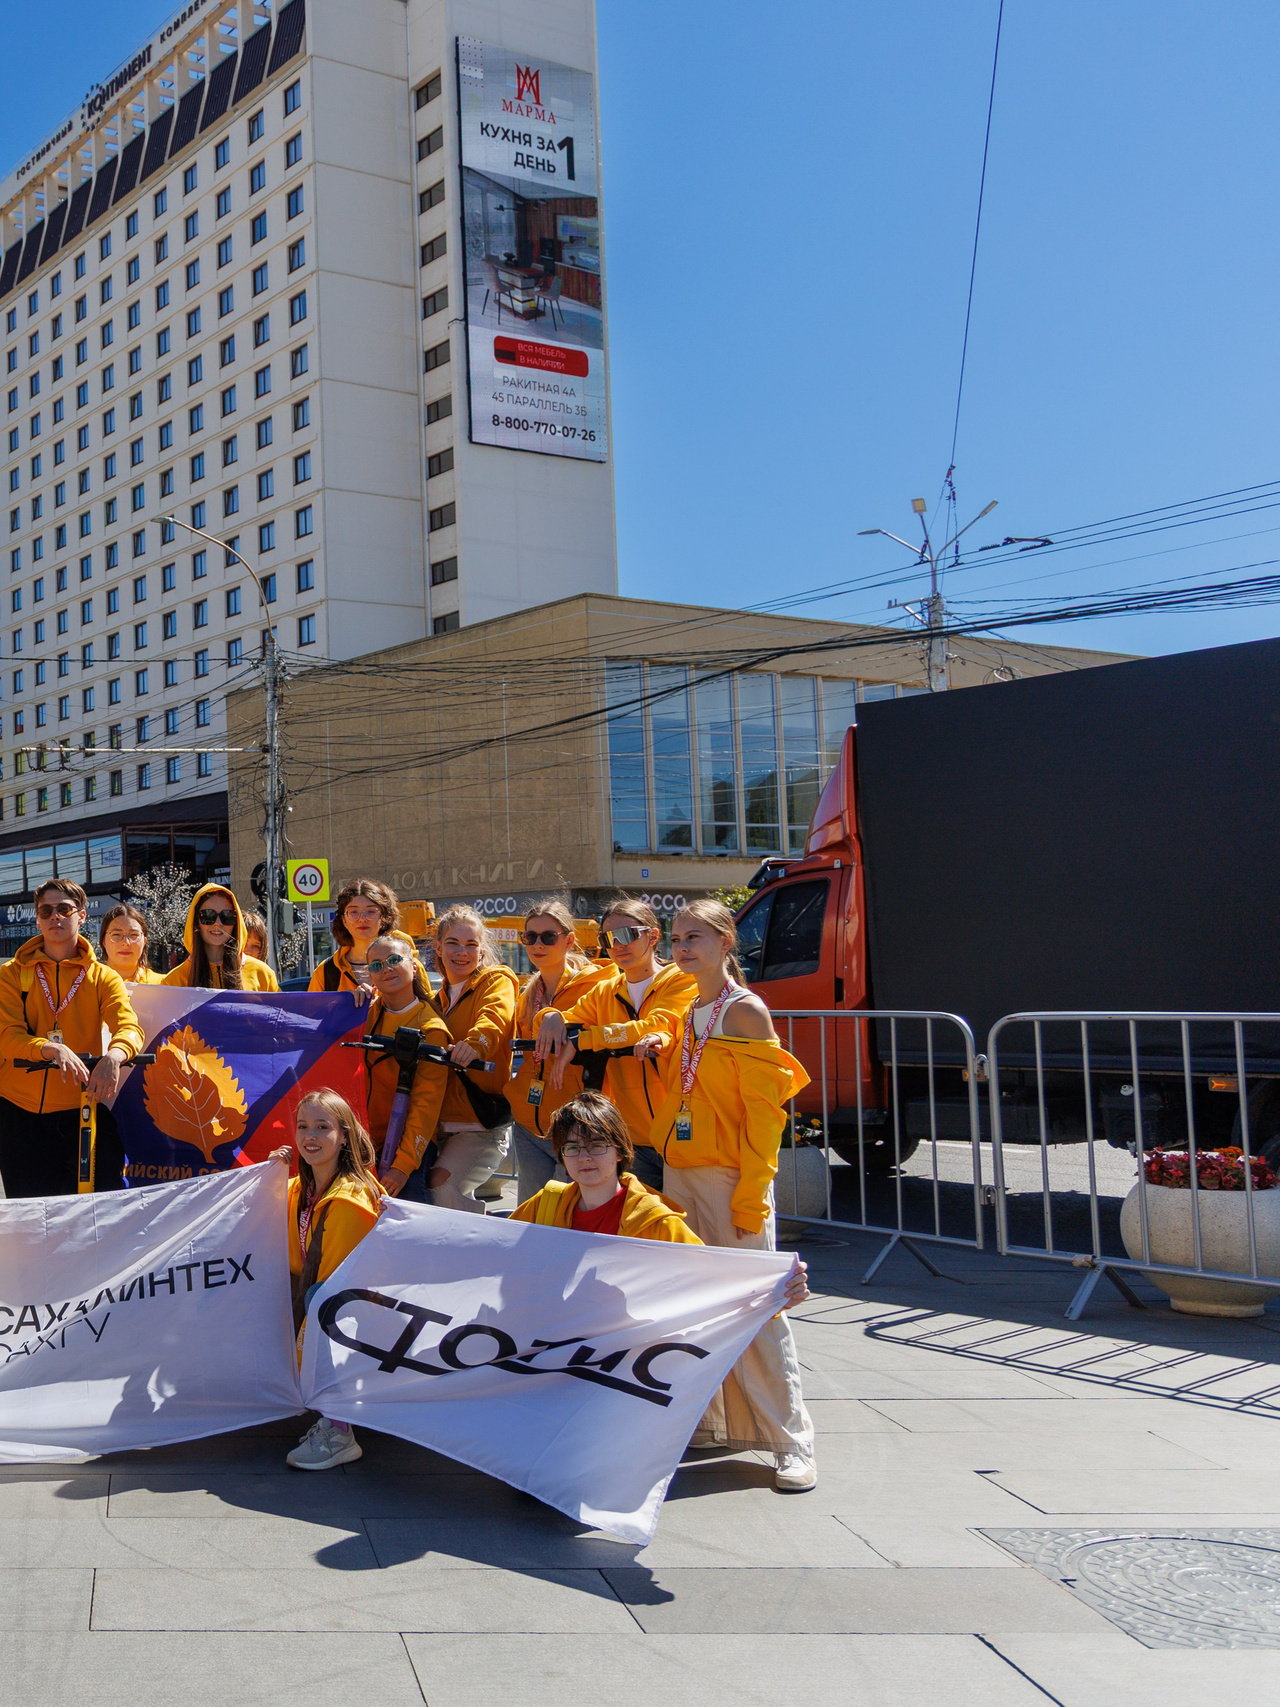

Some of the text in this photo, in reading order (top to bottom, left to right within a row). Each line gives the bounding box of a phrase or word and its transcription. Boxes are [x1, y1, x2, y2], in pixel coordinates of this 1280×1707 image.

[16, 120, 73, 181] ГОСТИНИЧНЫЙ
[87, 44, 153, 120] КОНТИНЕНТ
[501, 98, 557, 125] МАРМА
[480, 122, 576, 181] КУХНЯ ЗА 1
[513, 151, 556, 174] ДЕНЬ
[517, 342, 567, 359] ВСЯ МЕБЕЛЬ
[519, 355, 565, 370] В НАЛИЧИИ
[502, 375, 577, 398] РАКИТНАЯ 4А
[491, 391, 588, 417] 45 ПАРАЛЛЕЛЬ 3Б
[491, 414, 596, 442] 8-800-770-07-26
[298, 873, 318, 887] 40
[452, 859, 546, 886] КНИГИ
[473, 896, 517, 915] ecco
[641, 894, 687, 911] ecco
[505, 929, 516, 941] 89
[121, 1161, 193, 1180] ИЙСКИЙ
